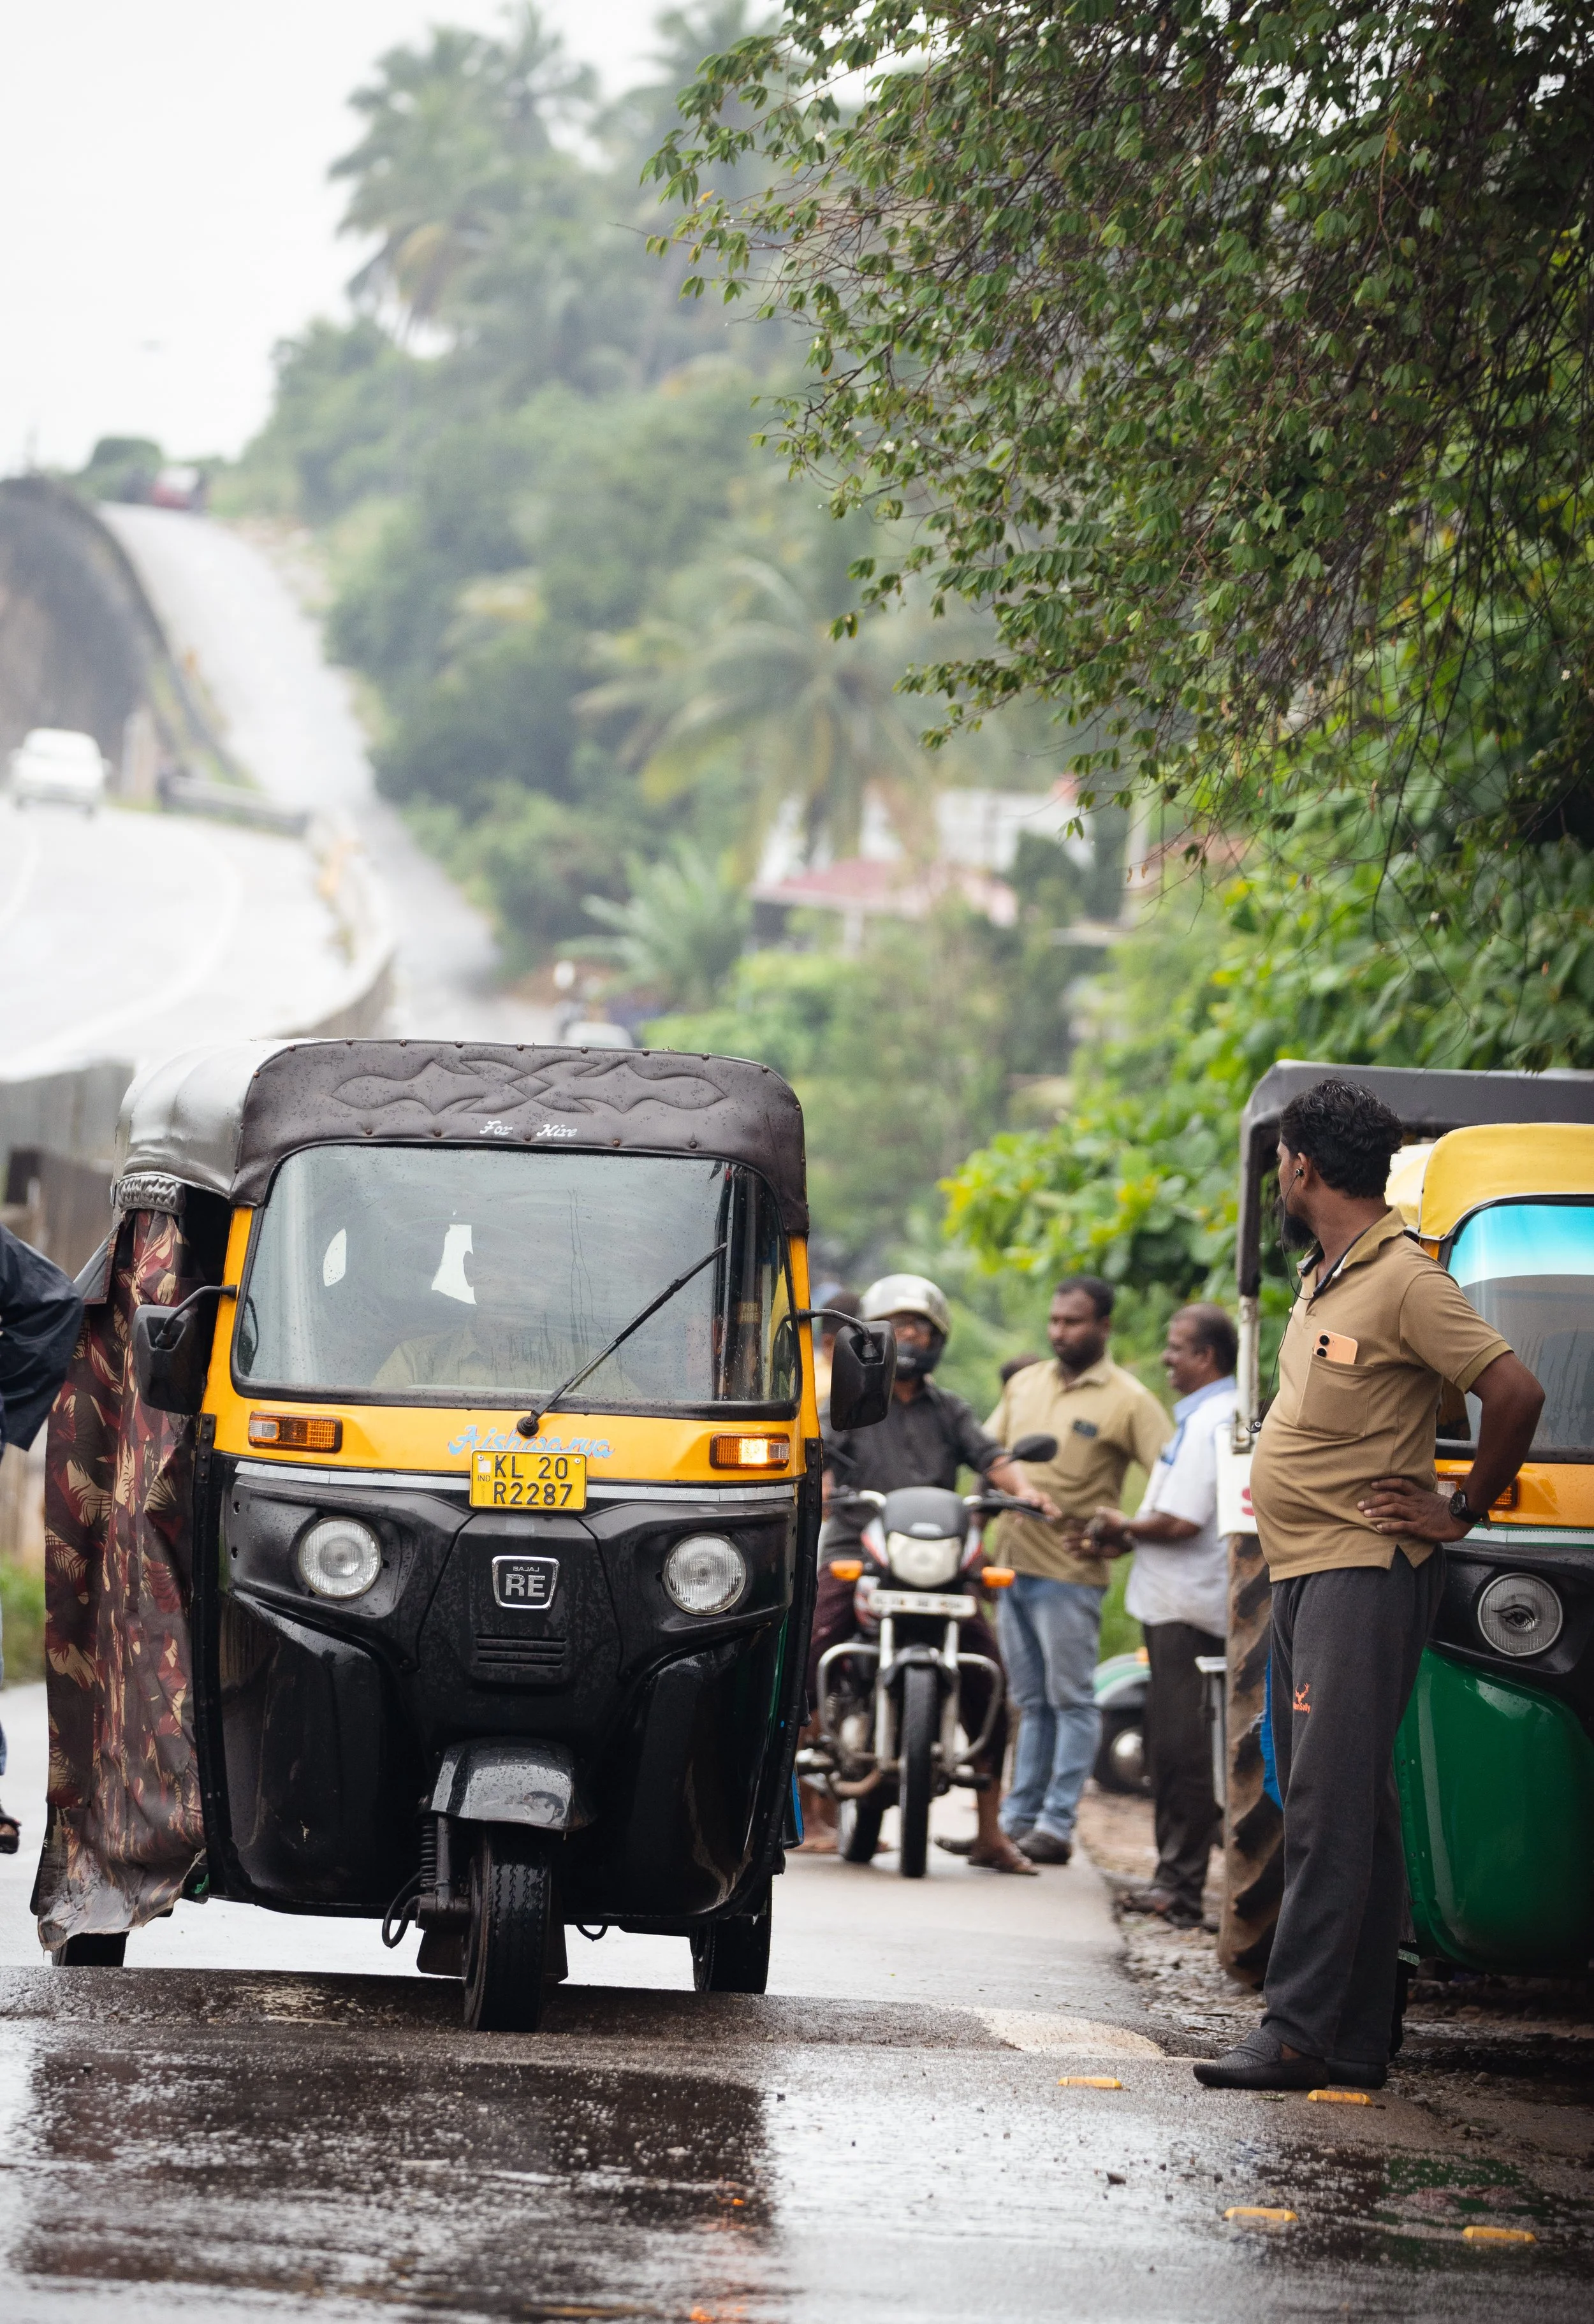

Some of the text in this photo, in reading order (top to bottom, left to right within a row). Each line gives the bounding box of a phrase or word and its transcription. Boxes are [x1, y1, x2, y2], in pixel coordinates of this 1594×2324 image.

[479, 1121, 577, 1137] For Hire
[741, 1312, 758, 1321] HIRE
[742, 1303, 757, 1312] FOR
[495, 1455, 567, 1479] KL 20
[494, 1481, 573, 1506] R2287
[506, 1574, 545, 1597] RE
